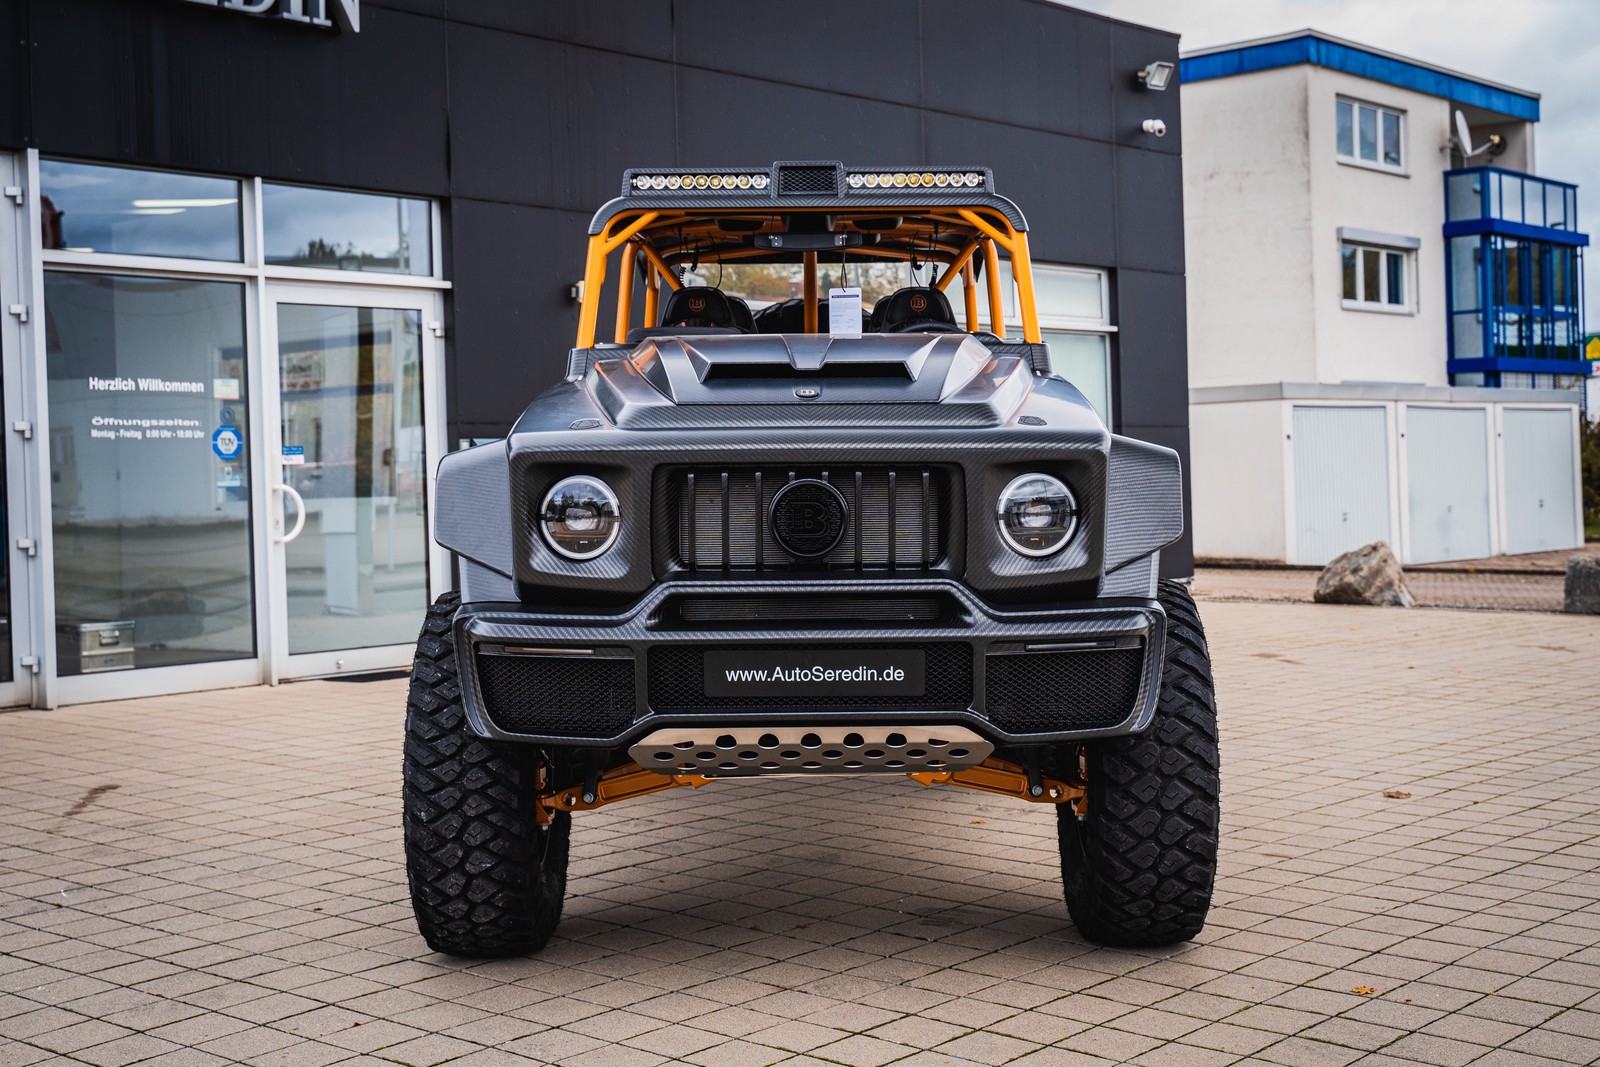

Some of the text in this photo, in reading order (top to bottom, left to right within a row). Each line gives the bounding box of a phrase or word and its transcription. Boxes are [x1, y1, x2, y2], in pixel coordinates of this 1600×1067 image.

[88, 377, 136, 391] Herzlich
[137, 378, 205, 393] Willkommen
[91, 429, 116, 440] Montag
[120, 429, 142, 440] Freitag
[160, 429, 172, 439] Uhr
[193, 430, 205, 439] Uhr
[220, 437, 235, 446] TÜV
[725, 665, 905, 682] www.AutoSeredin.de
